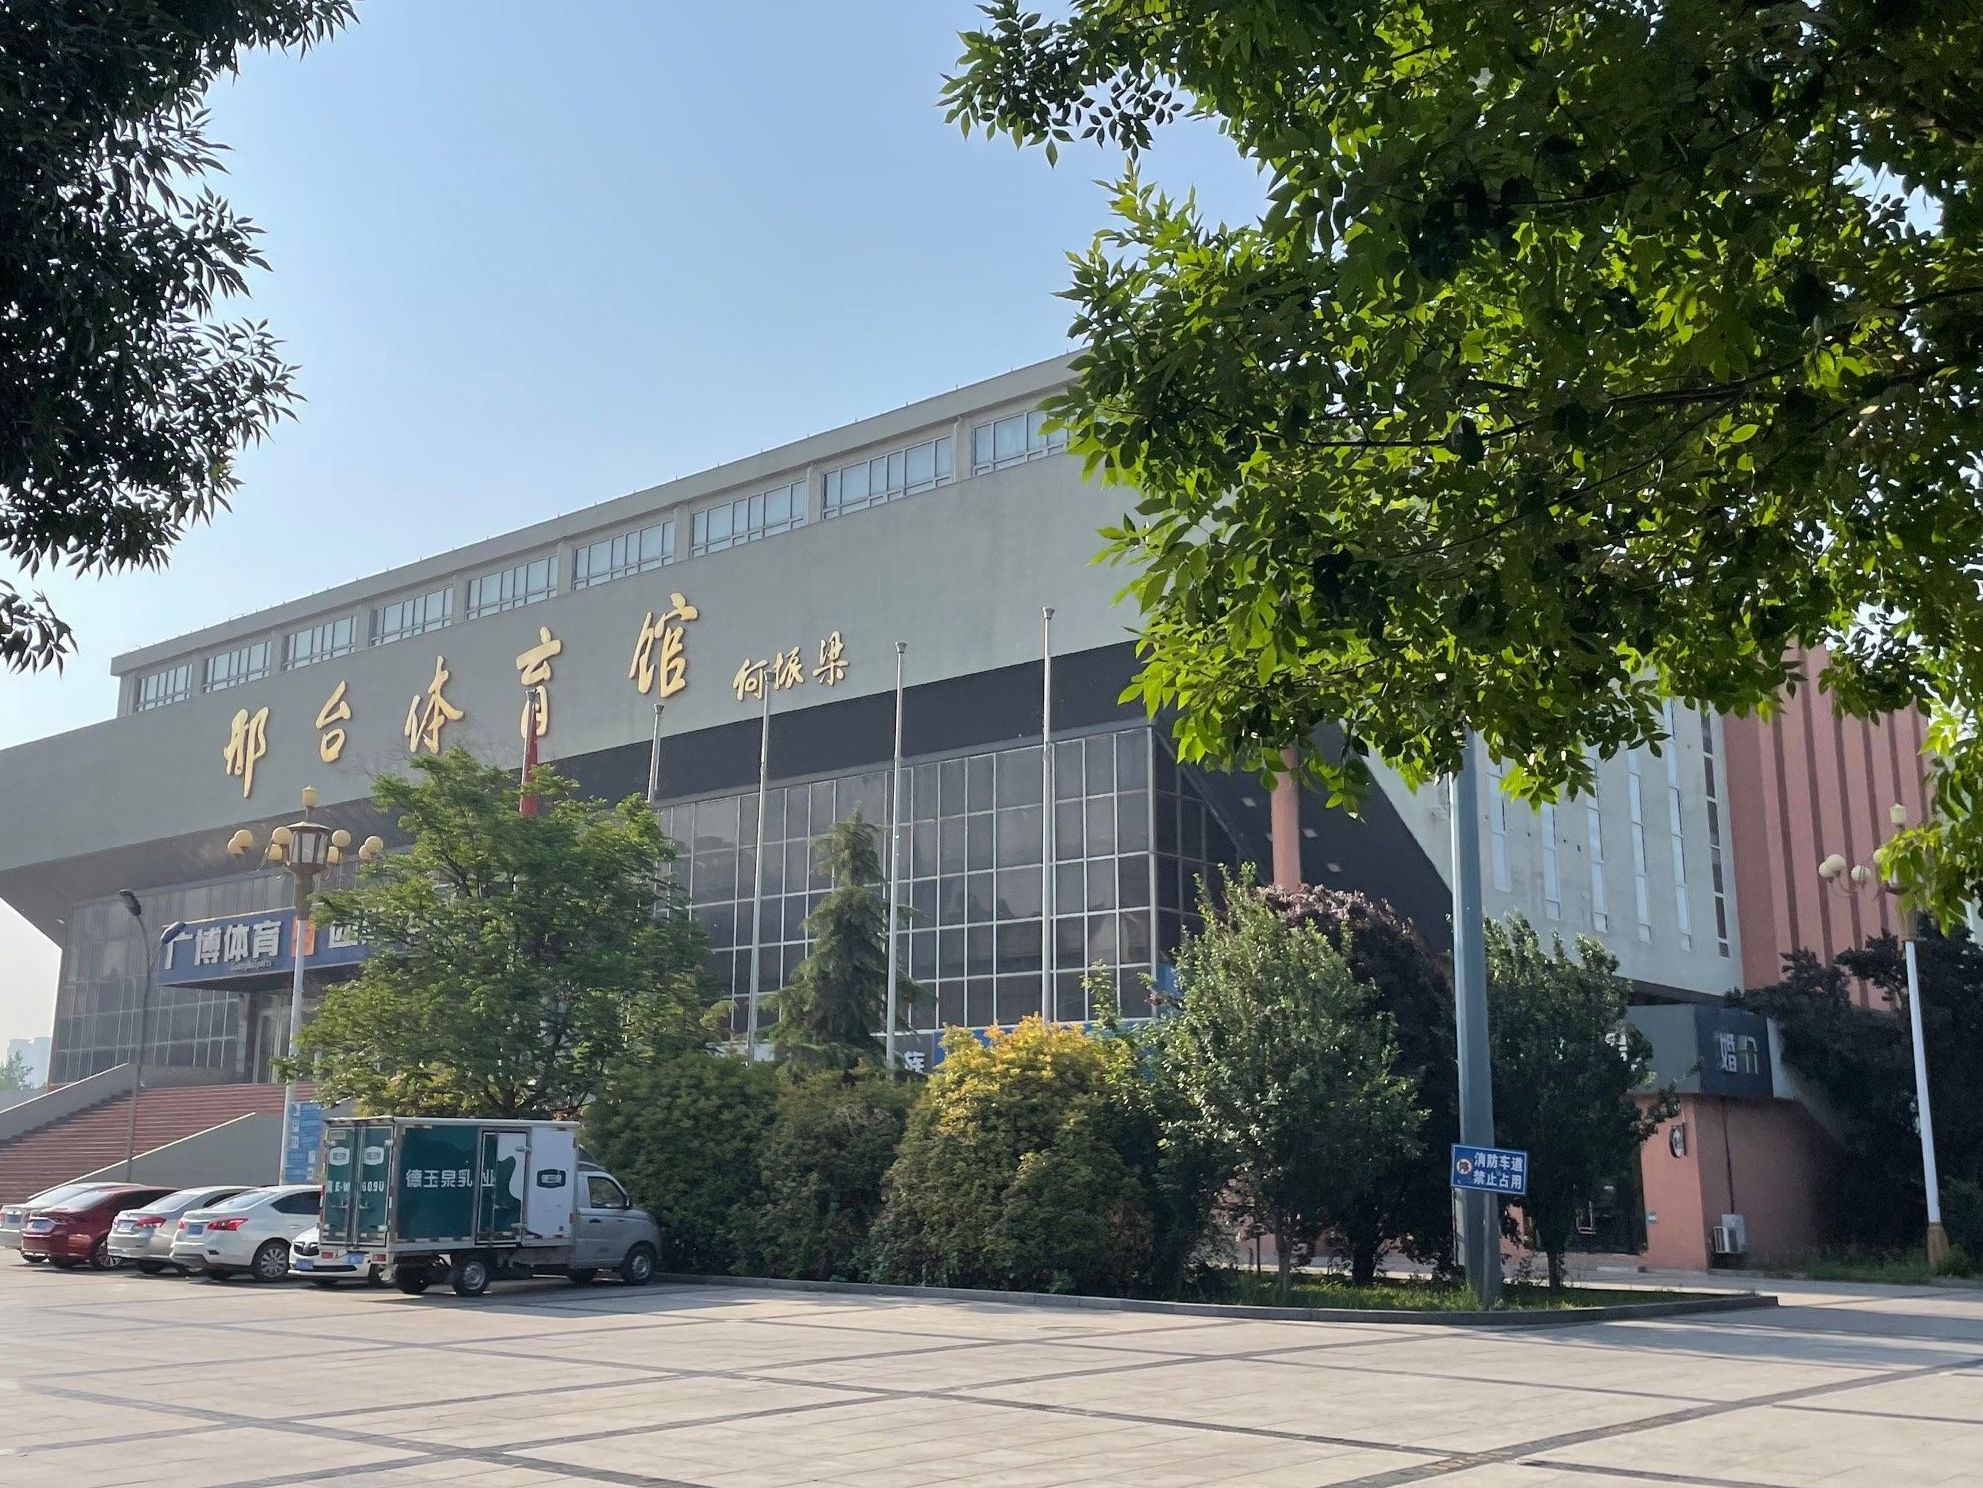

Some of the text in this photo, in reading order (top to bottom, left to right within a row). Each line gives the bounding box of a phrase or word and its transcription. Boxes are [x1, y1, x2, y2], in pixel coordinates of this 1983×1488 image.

[223, 592, 699, 799] 邢台体育馆
[164, 920, 282, 970] 广博体育
[1474, 1152, 1524, 1172] 消防车道
[405, 1168, 496, 1188] 德玉泉乳业
[1473, 1169, 1523, 1190] 禁止占用
